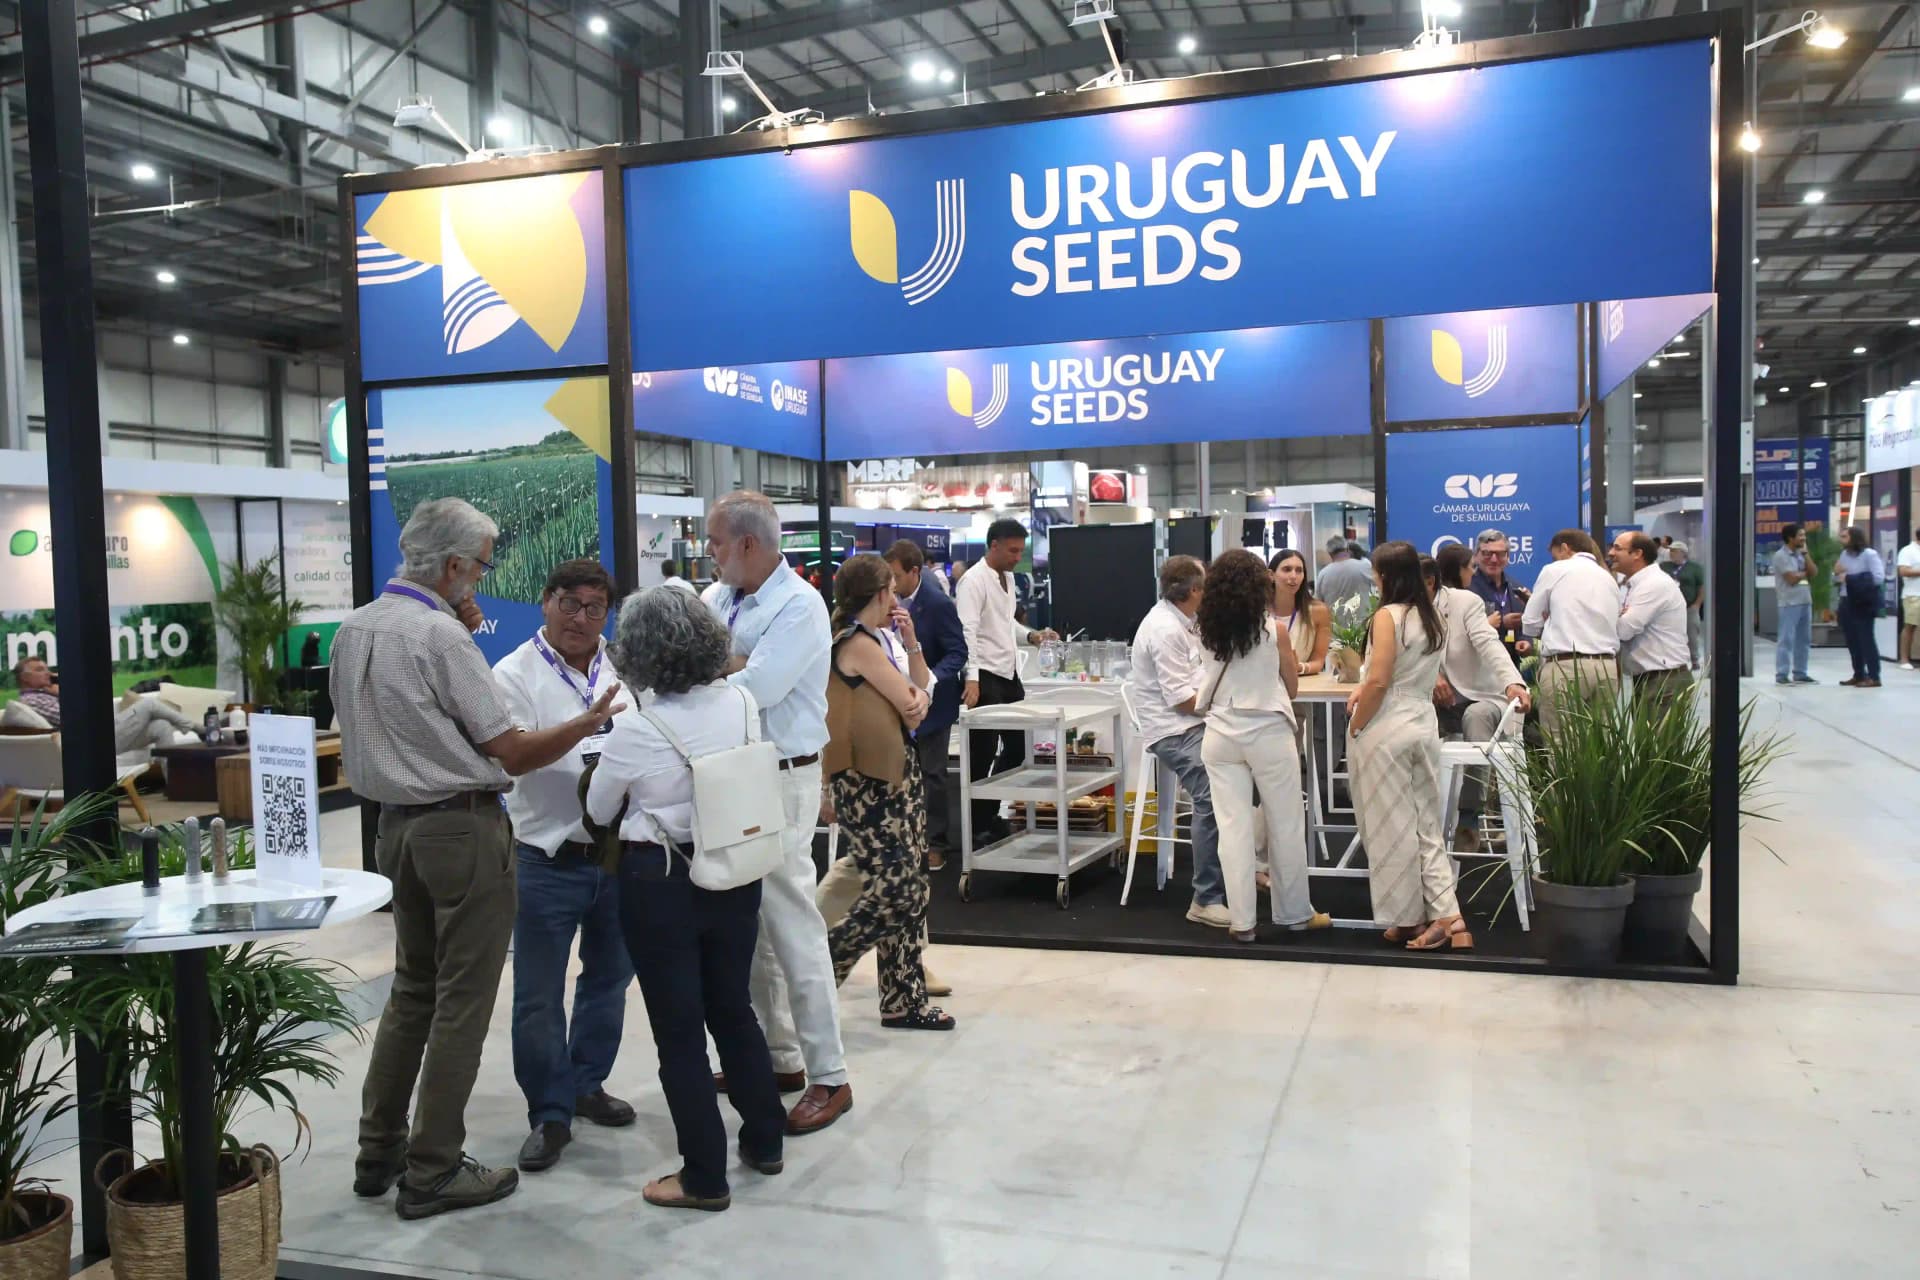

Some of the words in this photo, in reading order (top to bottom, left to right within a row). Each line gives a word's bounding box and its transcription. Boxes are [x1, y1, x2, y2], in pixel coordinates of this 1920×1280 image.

[1010, 130, 1398, 230] URUGUAY
[1010, 218, 1242, 297] SEEDS
[1031, 348, 1225, 392] URUGUAY
[784, 384, 808, 405] INASE
[1030, 388, 1149, 426] SEEDS
[1433, 503, 1475, 514] CÁMARA
[1477, 502, 1531, 513] URUGUAYA
[1451, 513, 1465, 522] DE
[1467, 512, 1512, 522] SEMILLAS
[1469, 535, 1534, 552] ISE
[294, 570, 330, 582] calidad
